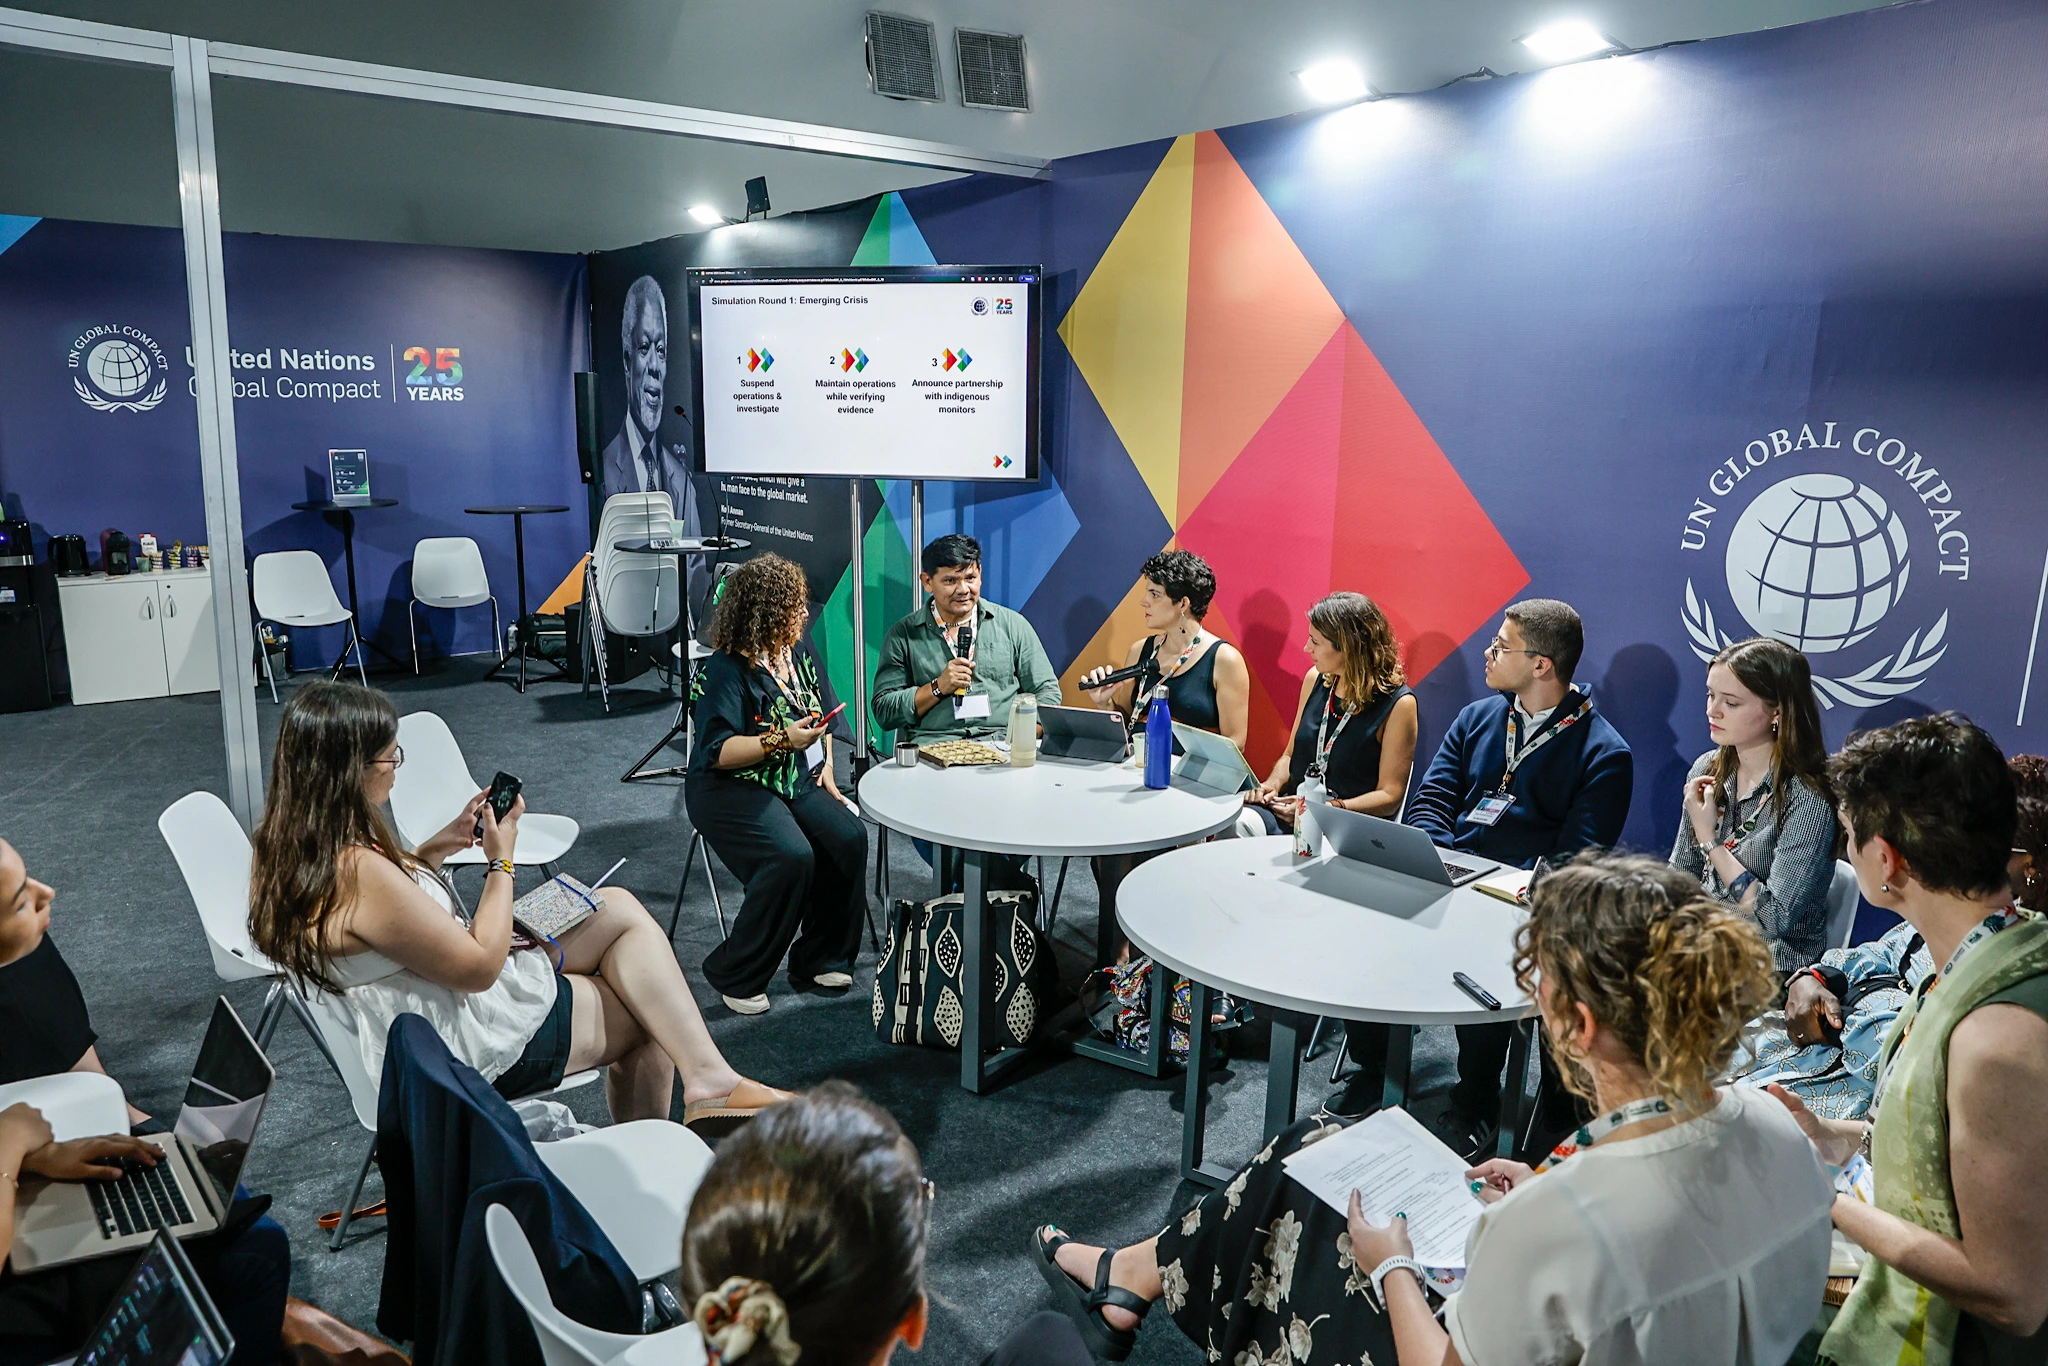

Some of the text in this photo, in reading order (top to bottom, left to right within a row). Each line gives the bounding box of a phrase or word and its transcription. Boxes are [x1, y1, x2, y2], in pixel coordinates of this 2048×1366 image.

[711, 295, 869, 306] Simulation Round 1: Emerging Crisis
[996, 297, 1013, 310] 25
[68, 323, 169, 371] UN GLOBAL COMPACT
[280, 348, 376, 371] Nations
[737, 356, 742, 365] 1
[829, 356, 836, 365] 2
[931, 357, 938, 367] 3
[403, 346, 463, 386] 25
[740, 379, 775, 389] Suspend
[815, 379, 896, 389] Maintain operations
[912, 379, 1004, 389] Announce partnership
[276, 376, 382, 404] Compact
[406, 386, 465, 402] YEARS
[733, 392, 782, 402] operations &
[826, 392, 886, 403] while verifying
[925, 392, 990, 402] with indigenous
[736, 404, 780, 414] investigate
[837, 405, 874, 414] evidence
[938, 405, 976, 414] monitors
[787, 477, 800, 488] give
[800, 478, 805, 487] a
[739, 483, 751, 495] face
[751, 486, 757, 496] to
[757, 486, 767, 498] the
[767, 488, 785, 501] global
[786, 491, 808, 503] market.
[1680, 421, 1970, 581] UN GLOBAL COMPACT
[721, 504, 743, 516] Koi Annan
[721, 517, 734, 526] Fomer
[735, 519, 769, 533] Secretary-General
[774, 525, 782, 536] the
[782, 528, 796, 538] United
[796, 530, 814, 542] Nations
